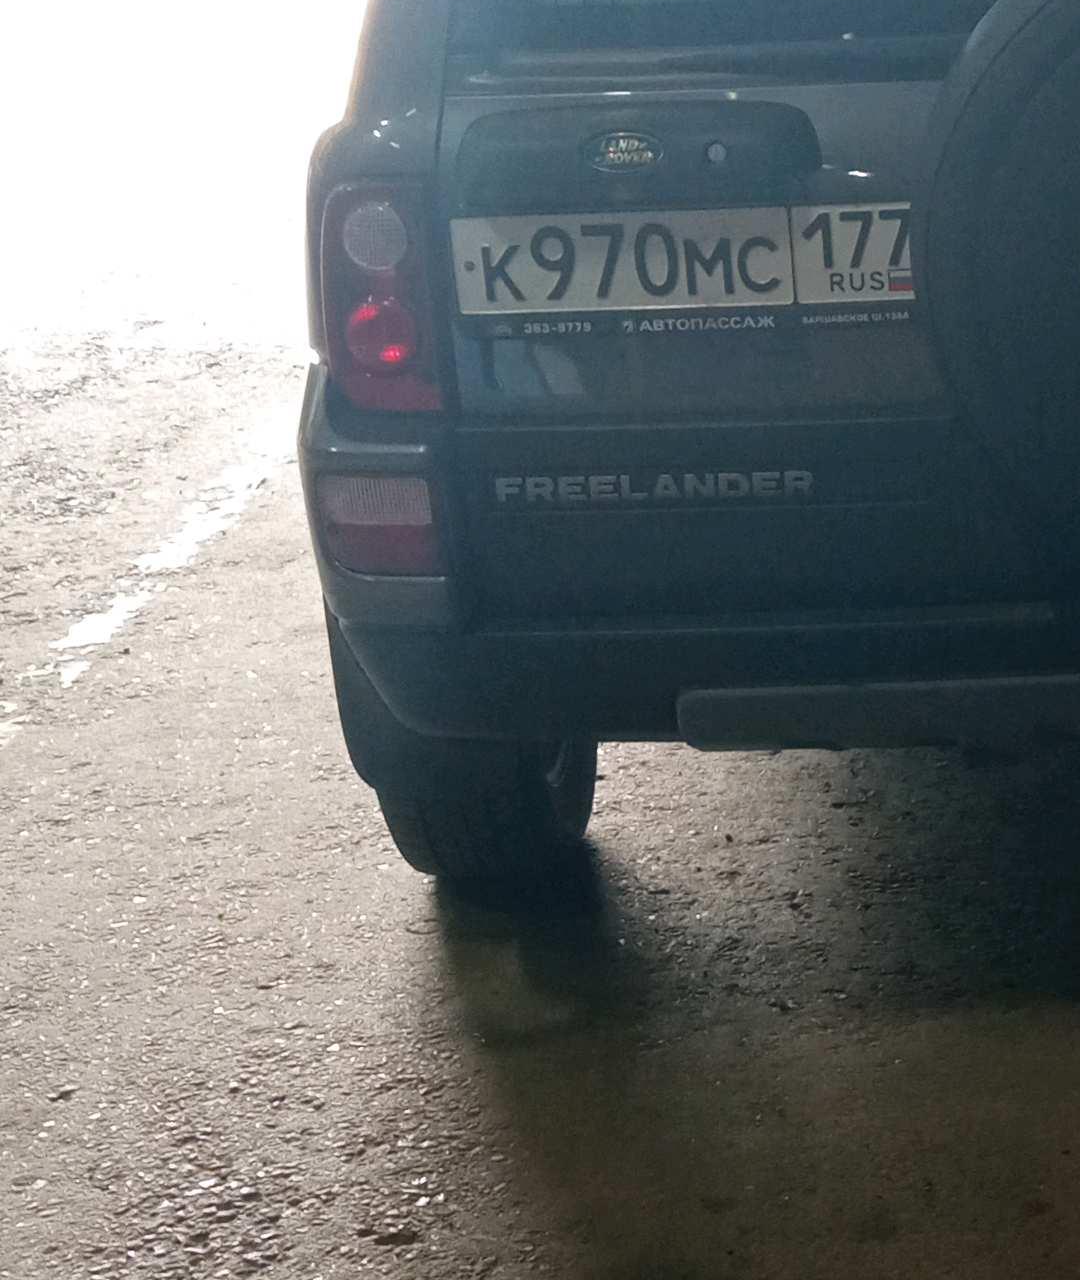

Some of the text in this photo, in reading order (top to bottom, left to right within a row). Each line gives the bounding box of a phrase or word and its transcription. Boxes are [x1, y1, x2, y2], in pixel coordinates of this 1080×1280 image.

[802, 209, 911, 269] 177
[481, 223, 782, 302] К970МС
[830, 271, 885, 293] RUS
[639, 315, 776, 332] АВТОПАССАЖ
[495, 470, 815, 502] FREELANDER
